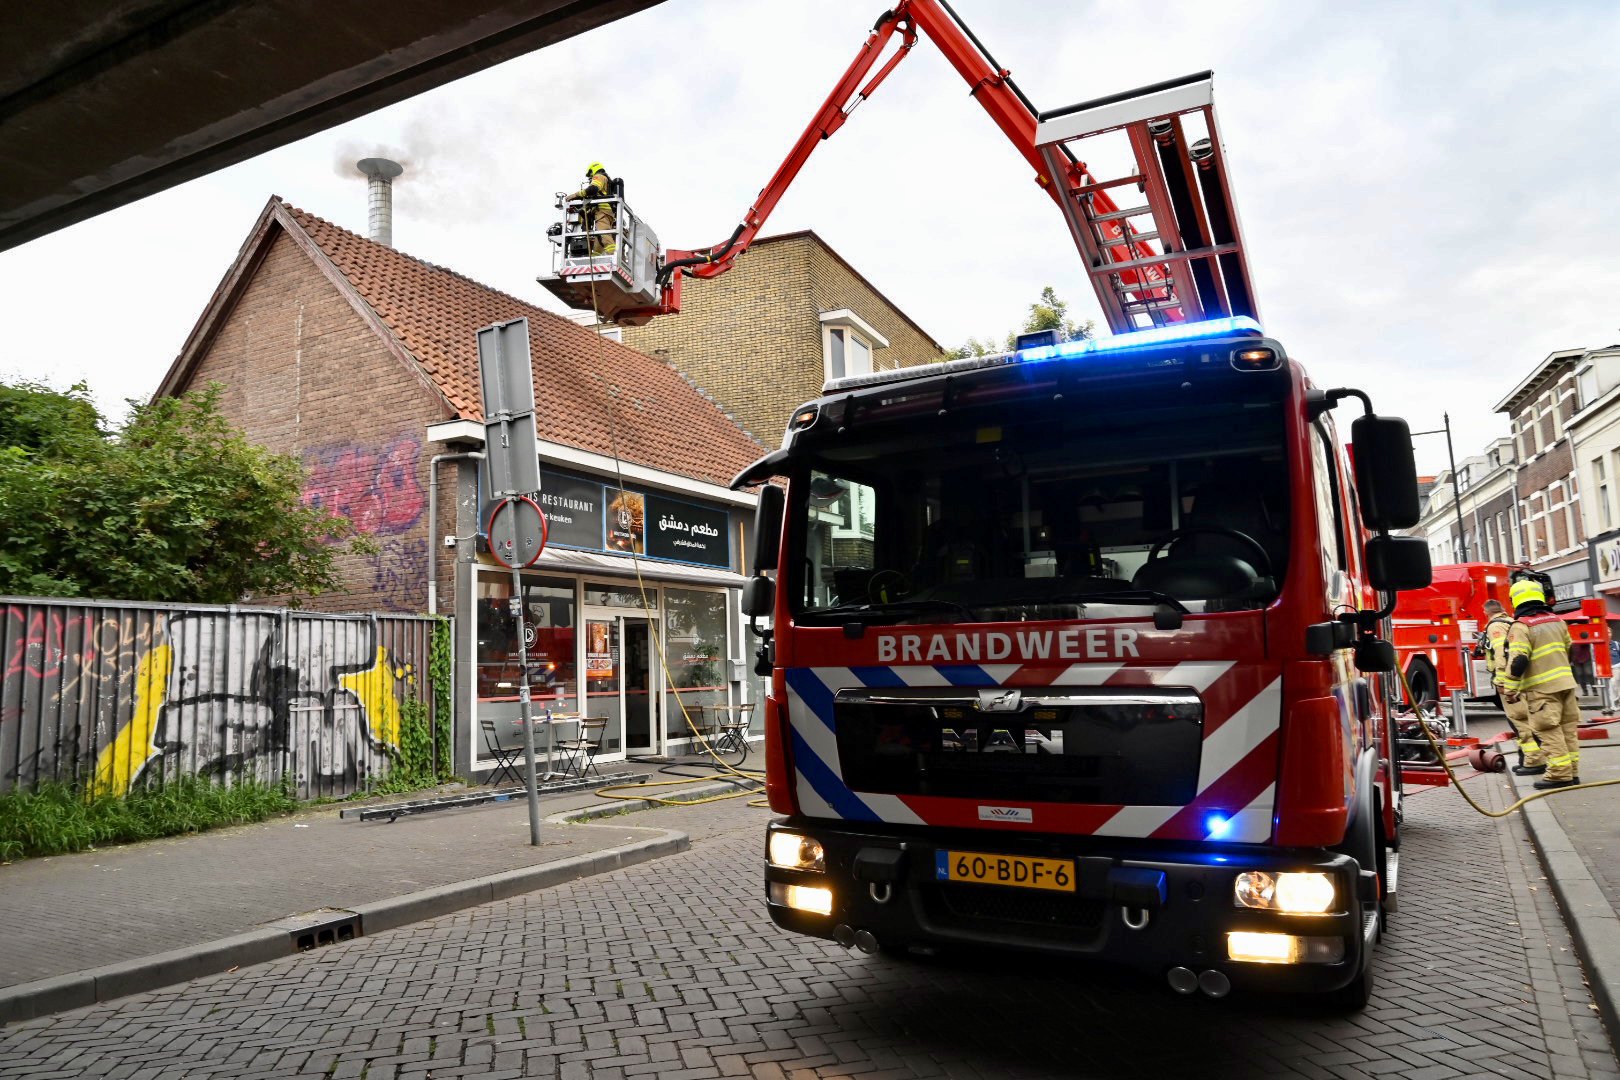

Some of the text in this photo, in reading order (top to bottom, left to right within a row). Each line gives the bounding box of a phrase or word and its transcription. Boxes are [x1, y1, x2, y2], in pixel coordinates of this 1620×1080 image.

[542, 493, 593, 512] RESTAURANT
[549, 512, 573, 524] keuken
[658, 514, 719, 537] مطعم دمشق
[877, 628, 1141, 662] BRANDWEER
[942, 728, 1064, 755] MAN
[937, 867, 947, 875] NL
[956, 856, 1069, 887] 60-BDF-6
